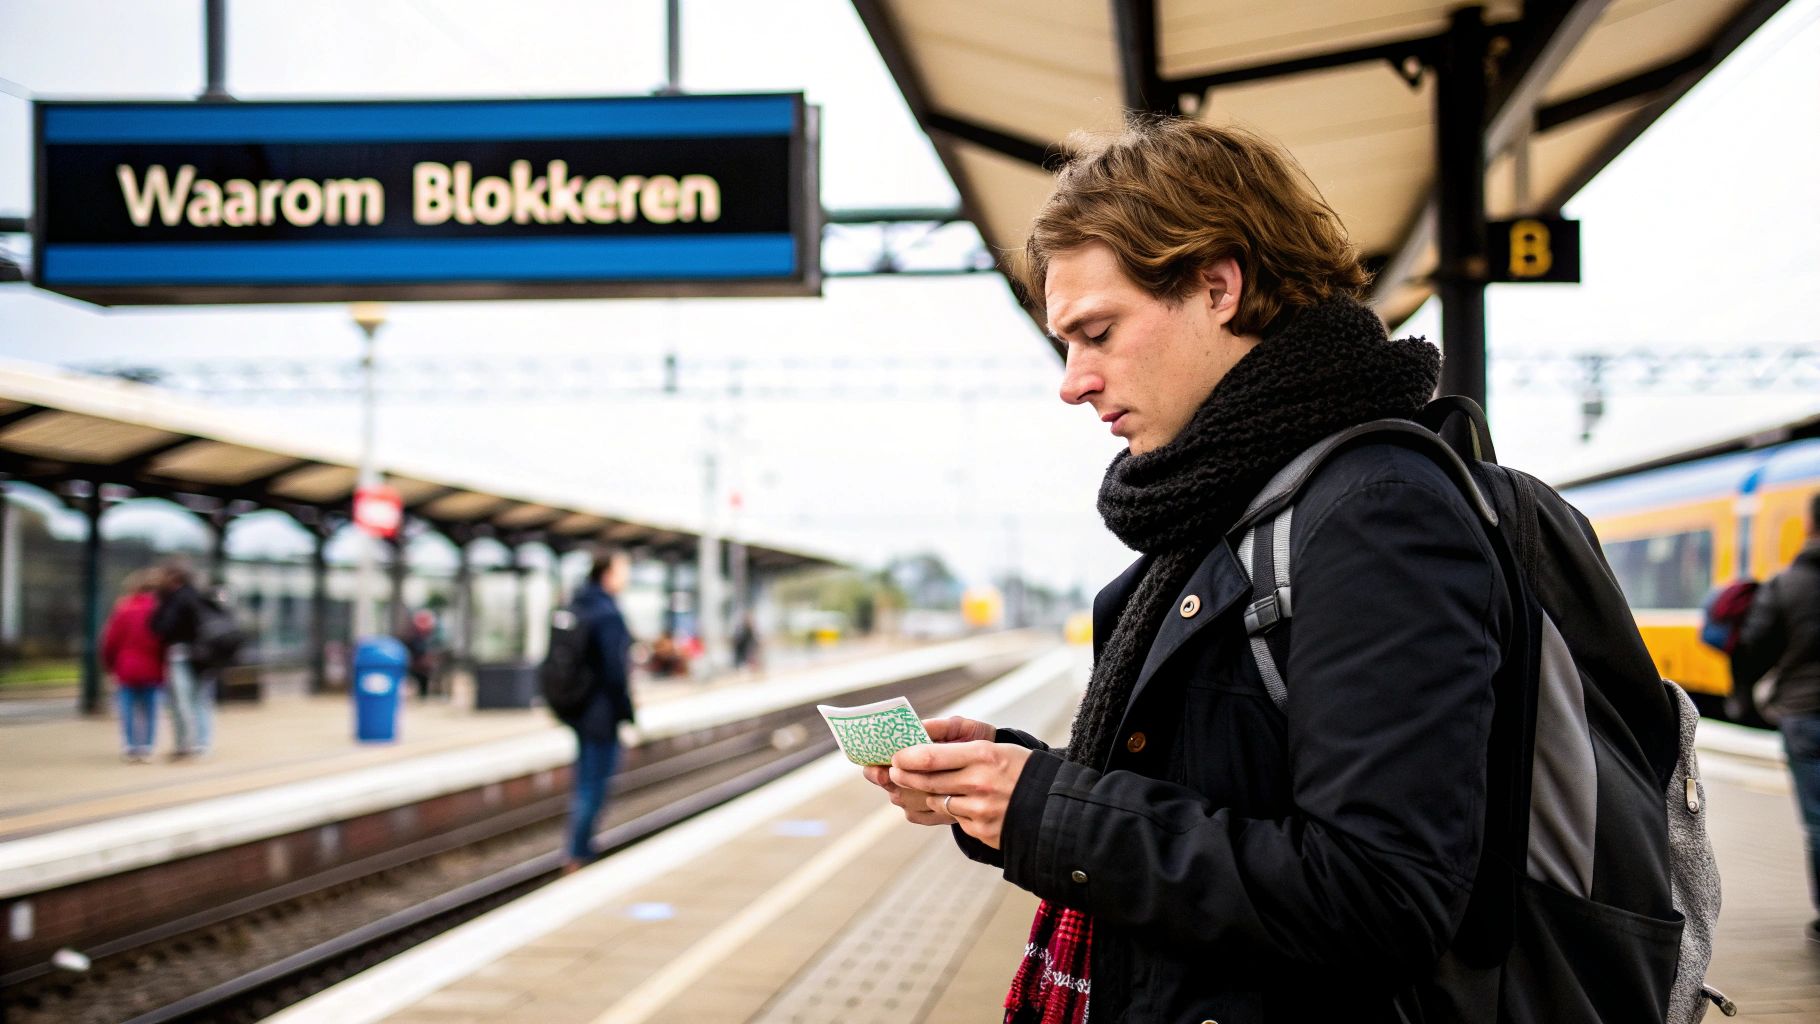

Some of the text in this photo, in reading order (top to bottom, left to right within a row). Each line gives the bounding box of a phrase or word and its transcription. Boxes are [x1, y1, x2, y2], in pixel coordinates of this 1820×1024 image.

[117, 159, 722, 227] Waarom Blokkeren
[1509, 219, 1553, 278] B
